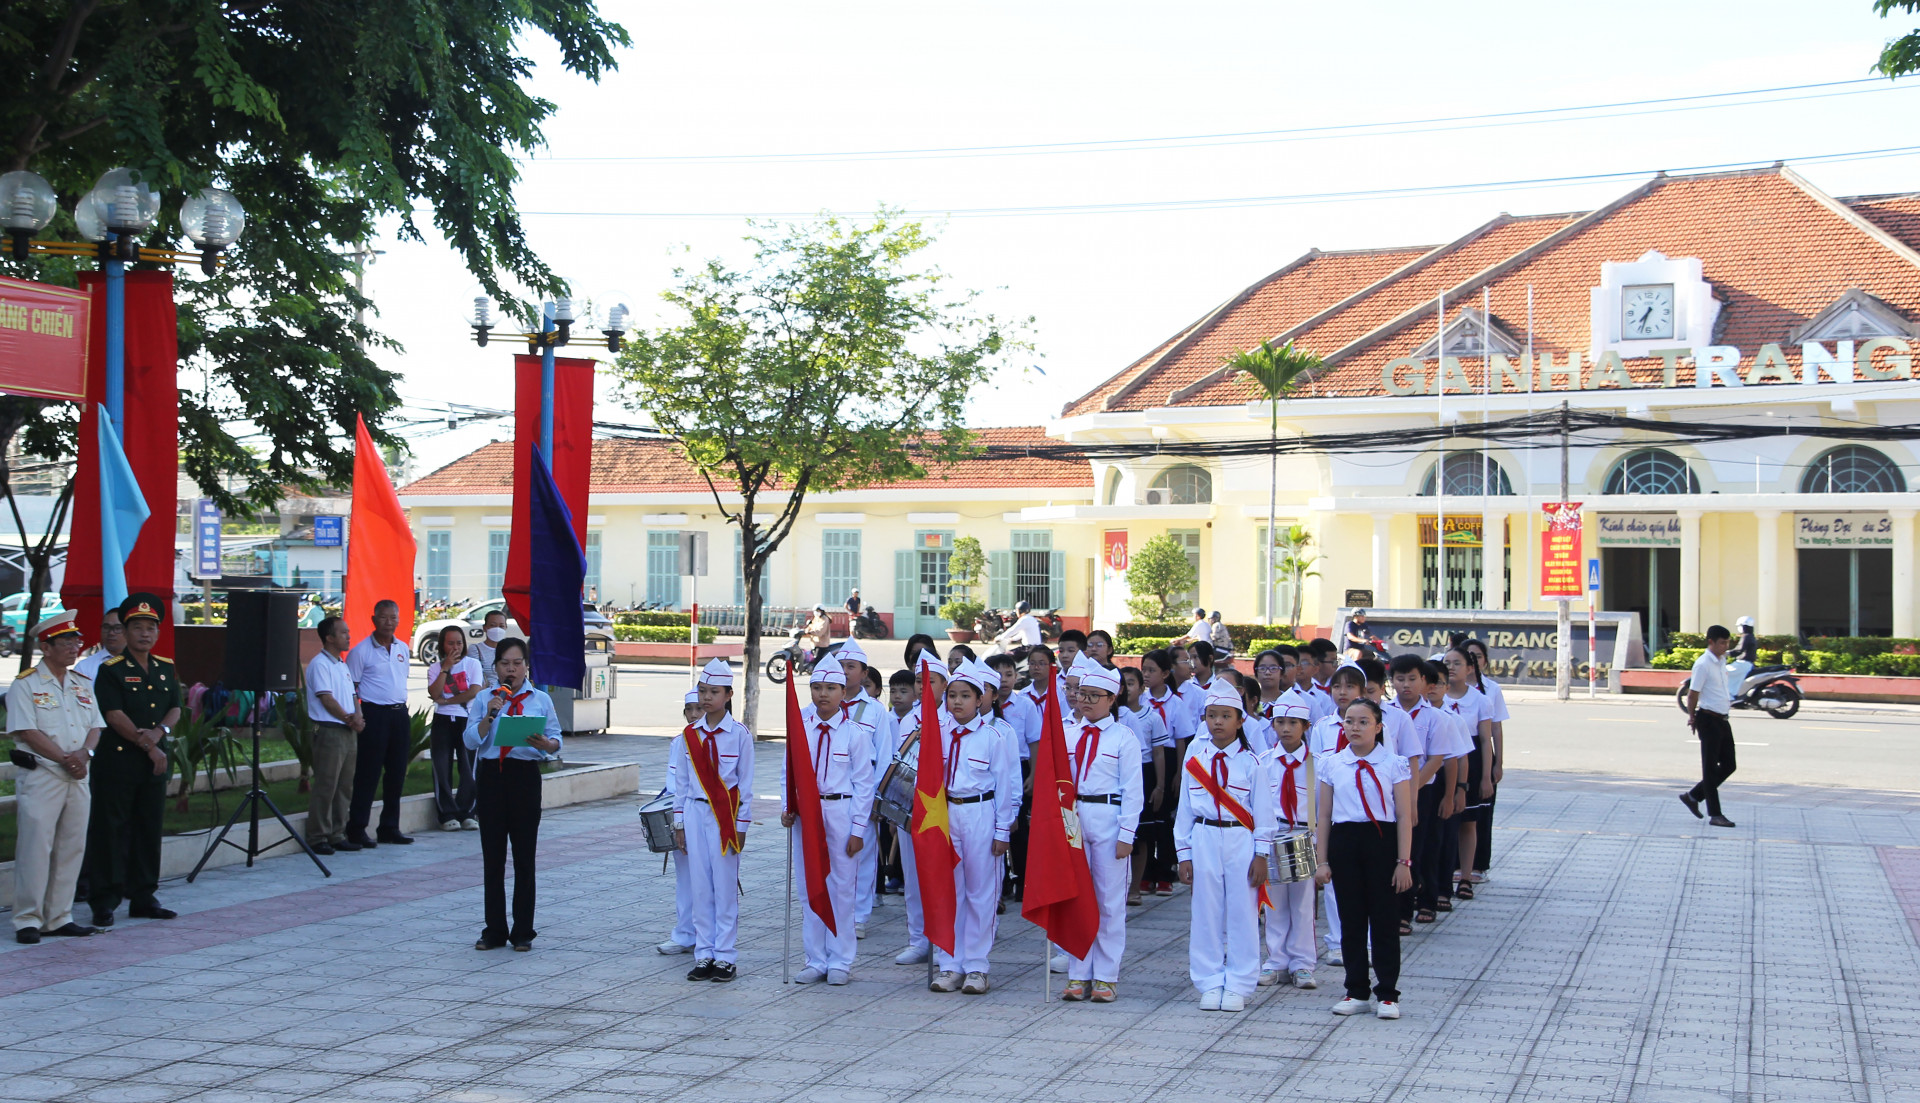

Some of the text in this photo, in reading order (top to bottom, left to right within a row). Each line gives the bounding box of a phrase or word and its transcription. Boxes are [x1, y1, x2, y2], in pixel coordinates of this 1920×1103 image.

[31, 305, 73, 338] CHIẾN
[1663, 308, 1670, 316] 3
[1644, 326, 1652, 334] 6
[1381, 337, 1913, 396] GA NHA TRANG
[1457, 522, 1483, 530] COFF
[1600, 517, 1624, 532] Kính
[1626, 518, 1647, 532] chào
[1667, 518, 1680, 532] kh
[1800, 517, 1829, 537] Phòng
[1833, 518, 1853, 536] Đợi
[1878, 518, 1892, 532] Số
[1394, 628, 1558, 649] GA NA TRANG
[1484, 654, 1520, 677] UÝ
